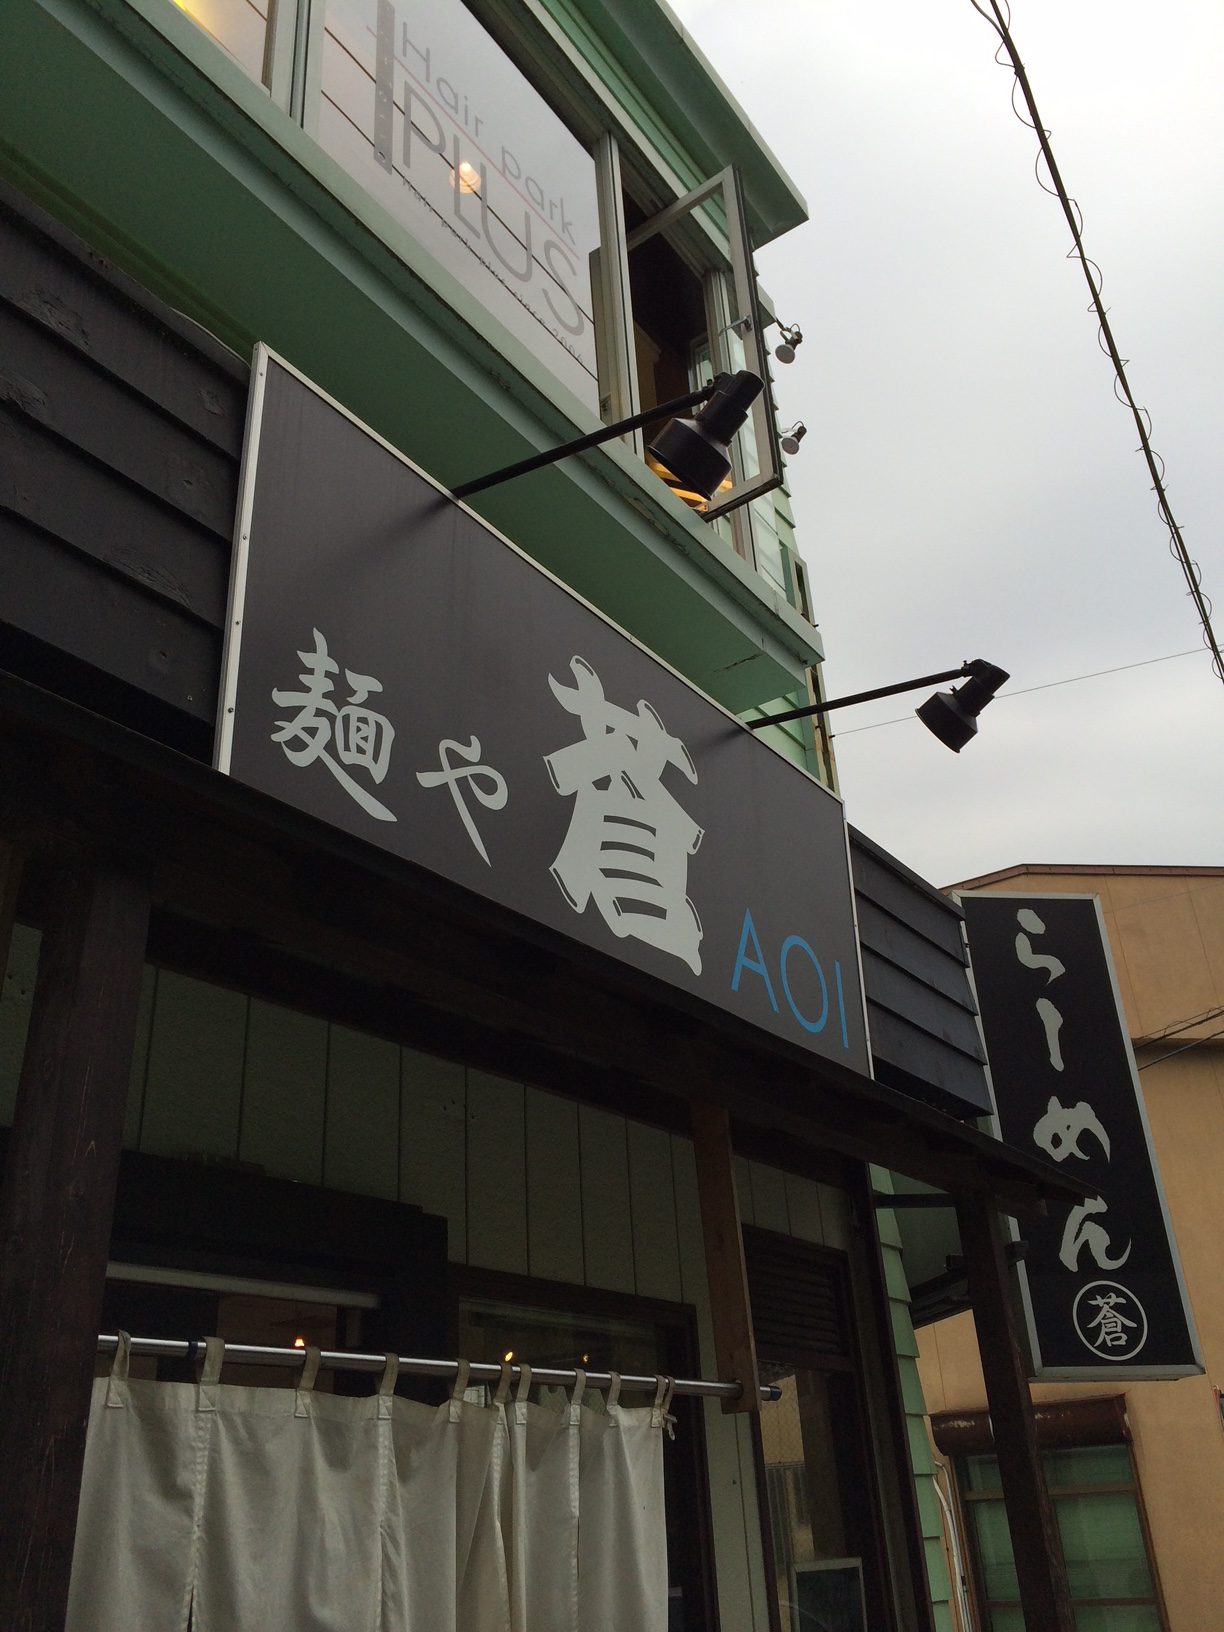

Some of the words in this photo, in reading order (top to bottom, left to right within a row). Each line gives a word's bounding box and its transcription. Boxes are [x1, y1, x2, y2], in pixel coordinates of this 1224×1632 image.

[402, 21, 484, 138] Hair
[501, 145, 576, 246] park
[402, 80, 585, 336] PLUS
[731, 907, 849, 1049] AOI
[1015, 908, 1132, 1272] らーめん
[1085, 1292, 1139, 1350] 蒼
